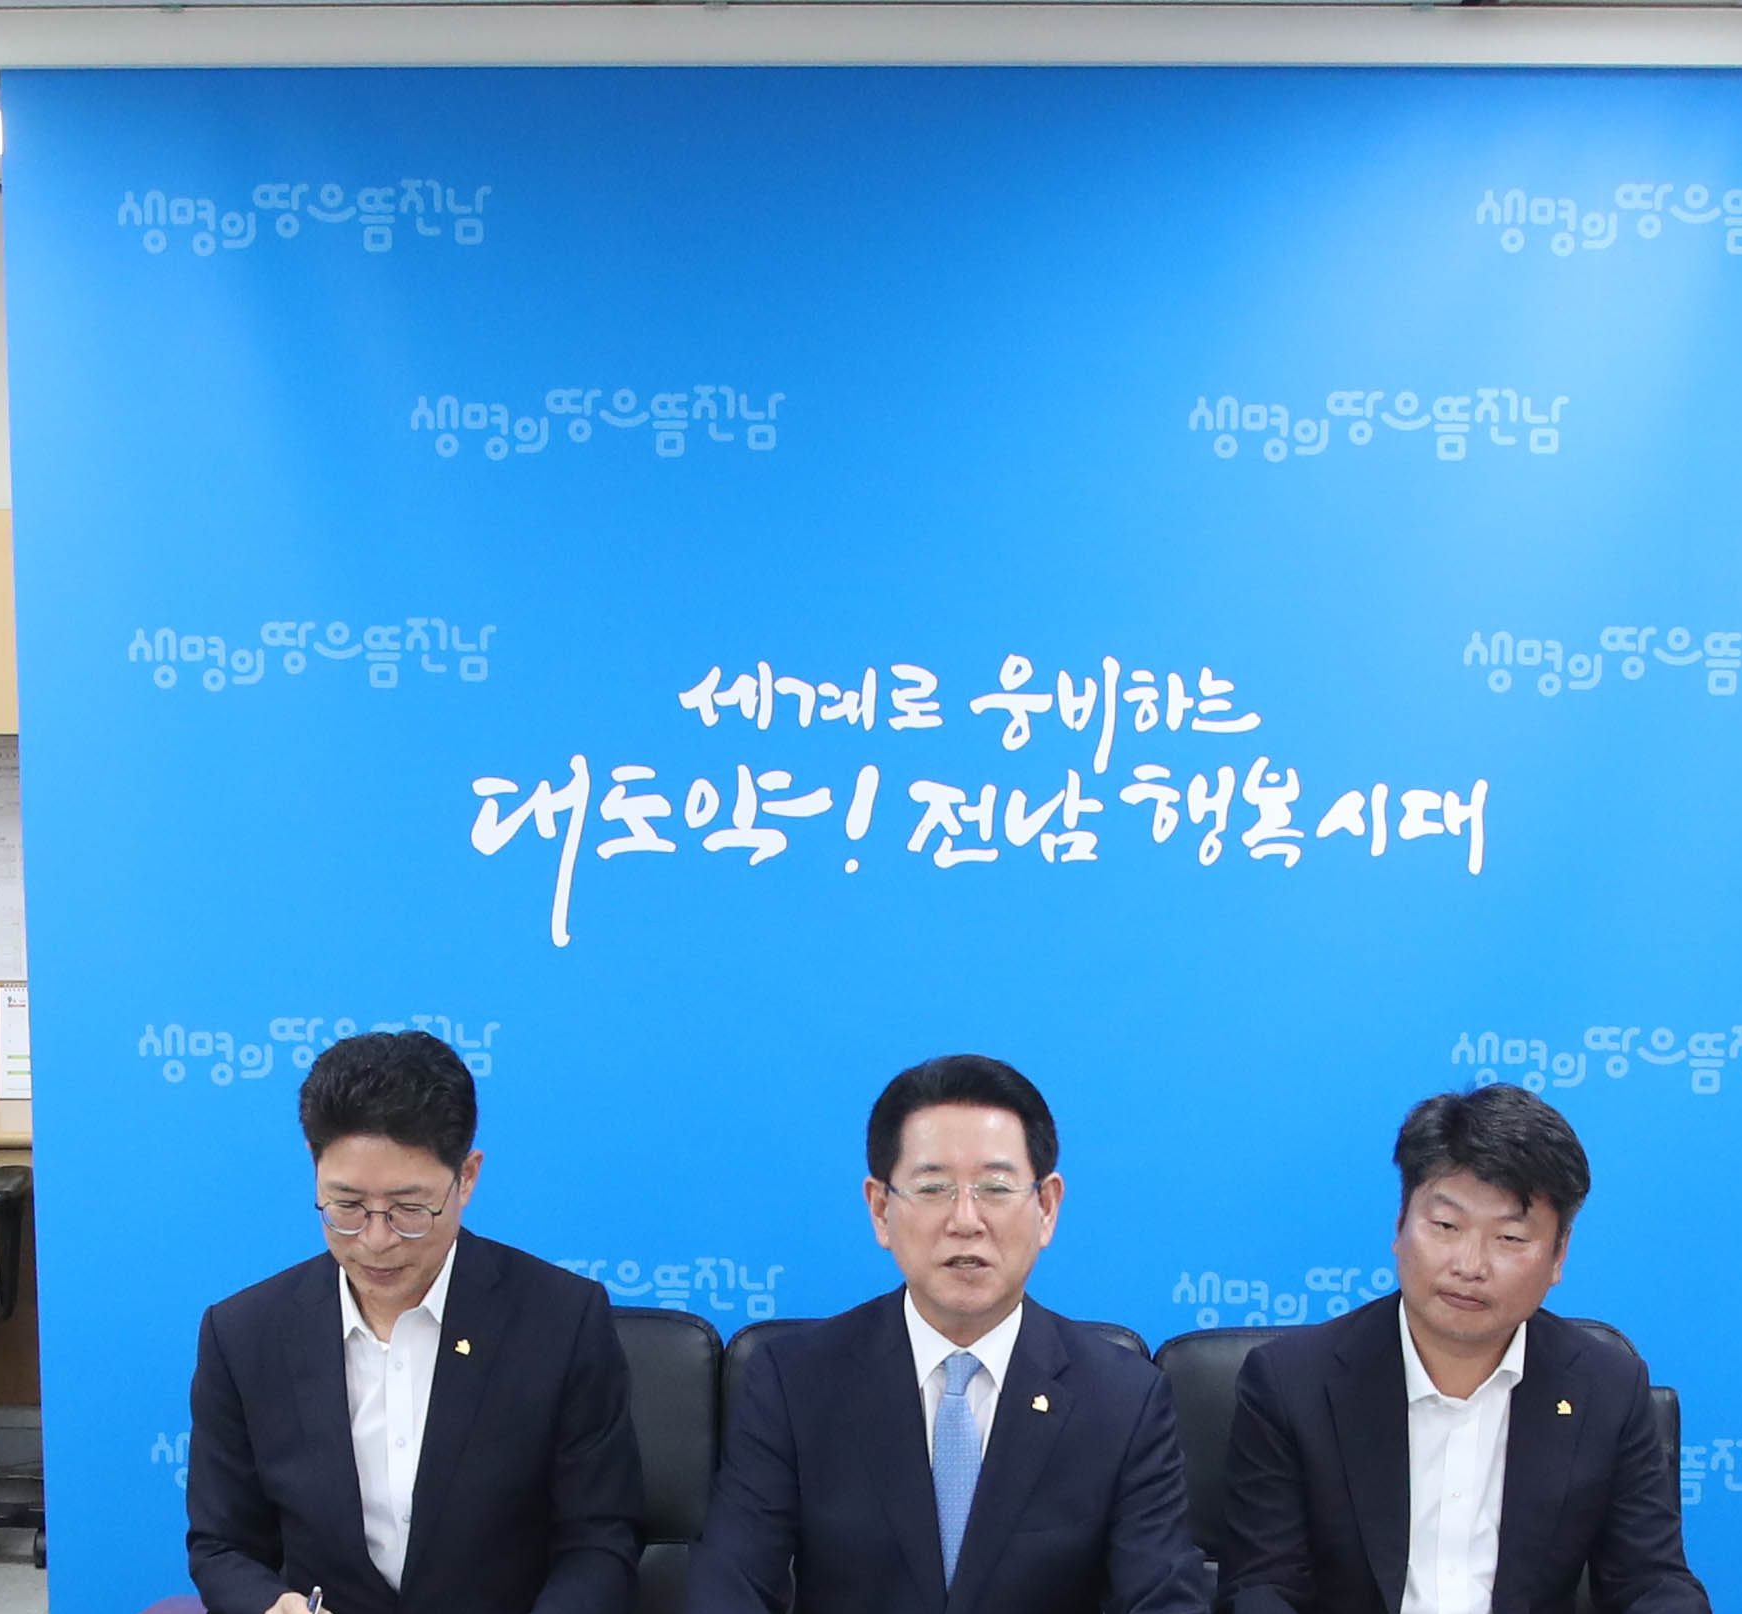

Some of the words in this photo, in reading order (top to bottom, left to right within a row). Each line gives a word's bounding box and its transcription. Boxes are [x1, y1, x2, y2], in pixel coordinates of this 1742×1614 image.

[679, 660, 945, 731] 세계로
[968, 653, 1261, 772] 웅비하는
[470, 754, 880, 948] 대도약!
[908, 768, 1103, 867] 전남
